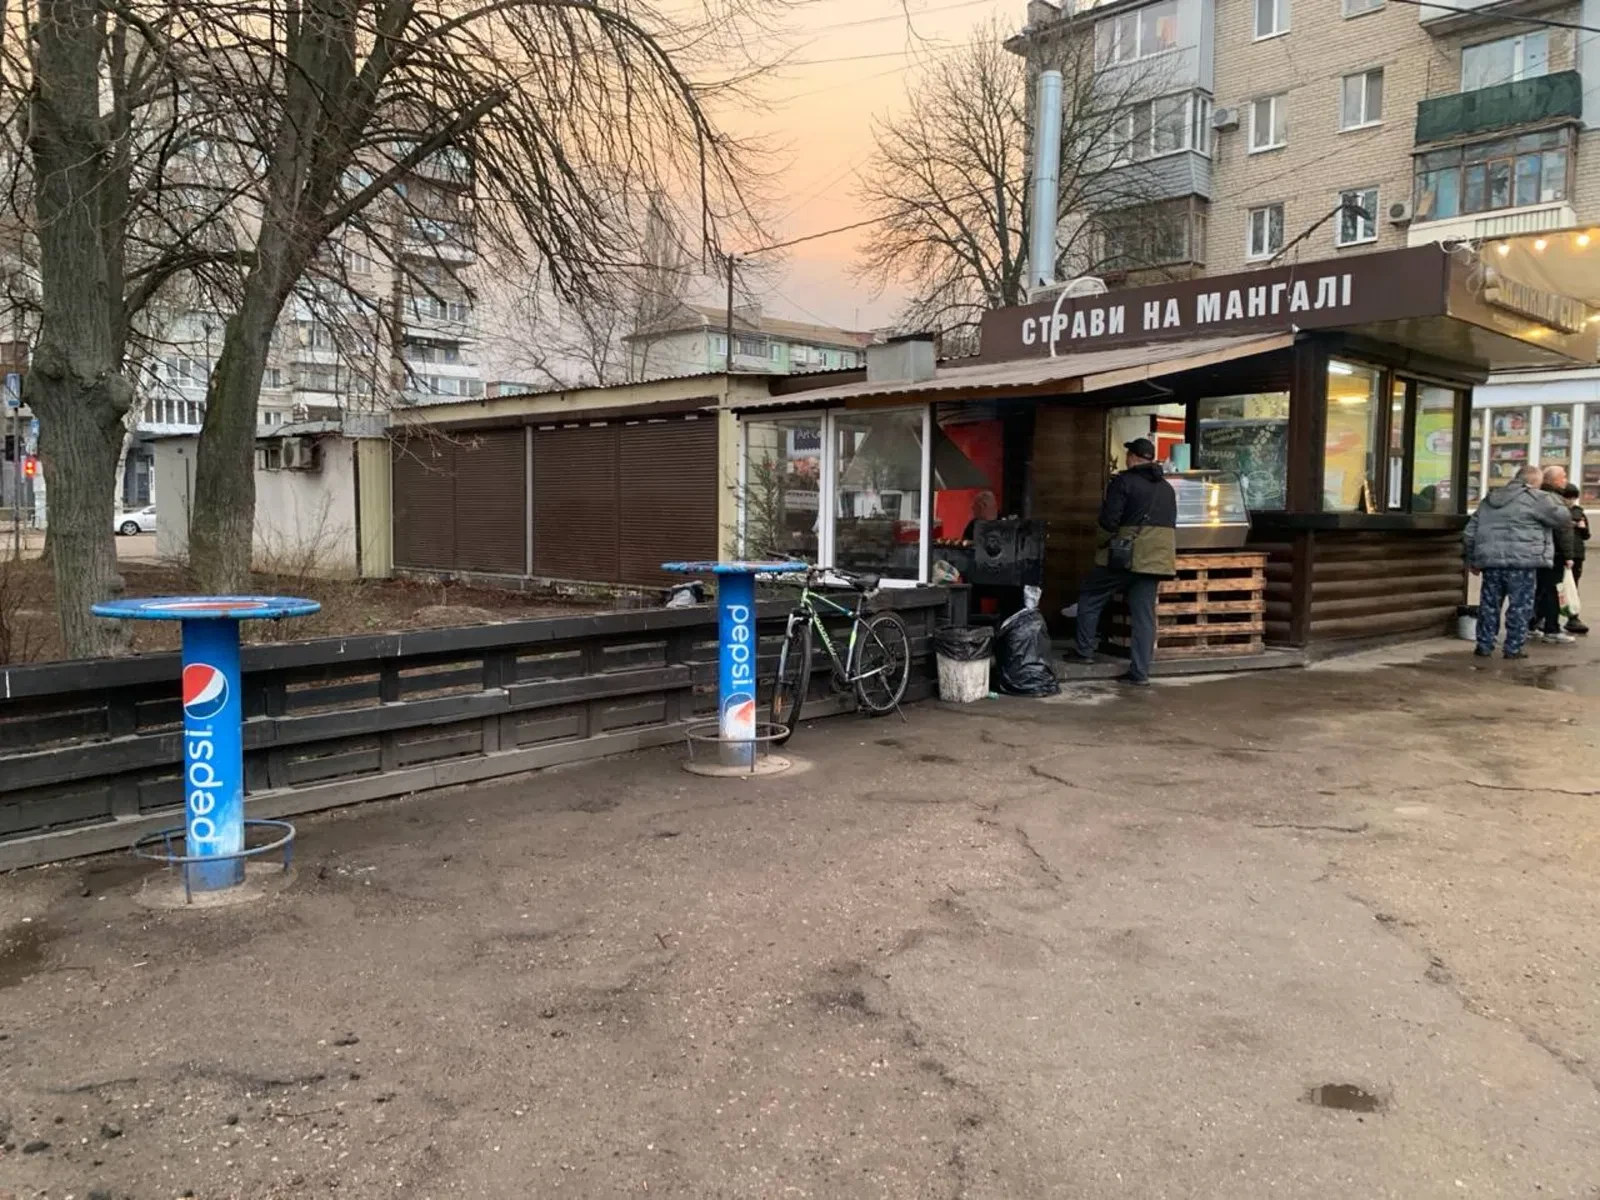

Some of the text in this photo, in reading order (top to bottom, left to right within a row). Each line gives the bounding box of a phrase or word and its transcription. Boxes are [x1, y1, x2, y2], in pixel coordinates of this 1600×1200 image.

[1022, 273, 1352, 346] СТРАВИ НА МАНГАЛІ
[726, 604, 753, 685] pepsi
[184, 729, 224, 843] pepsi
